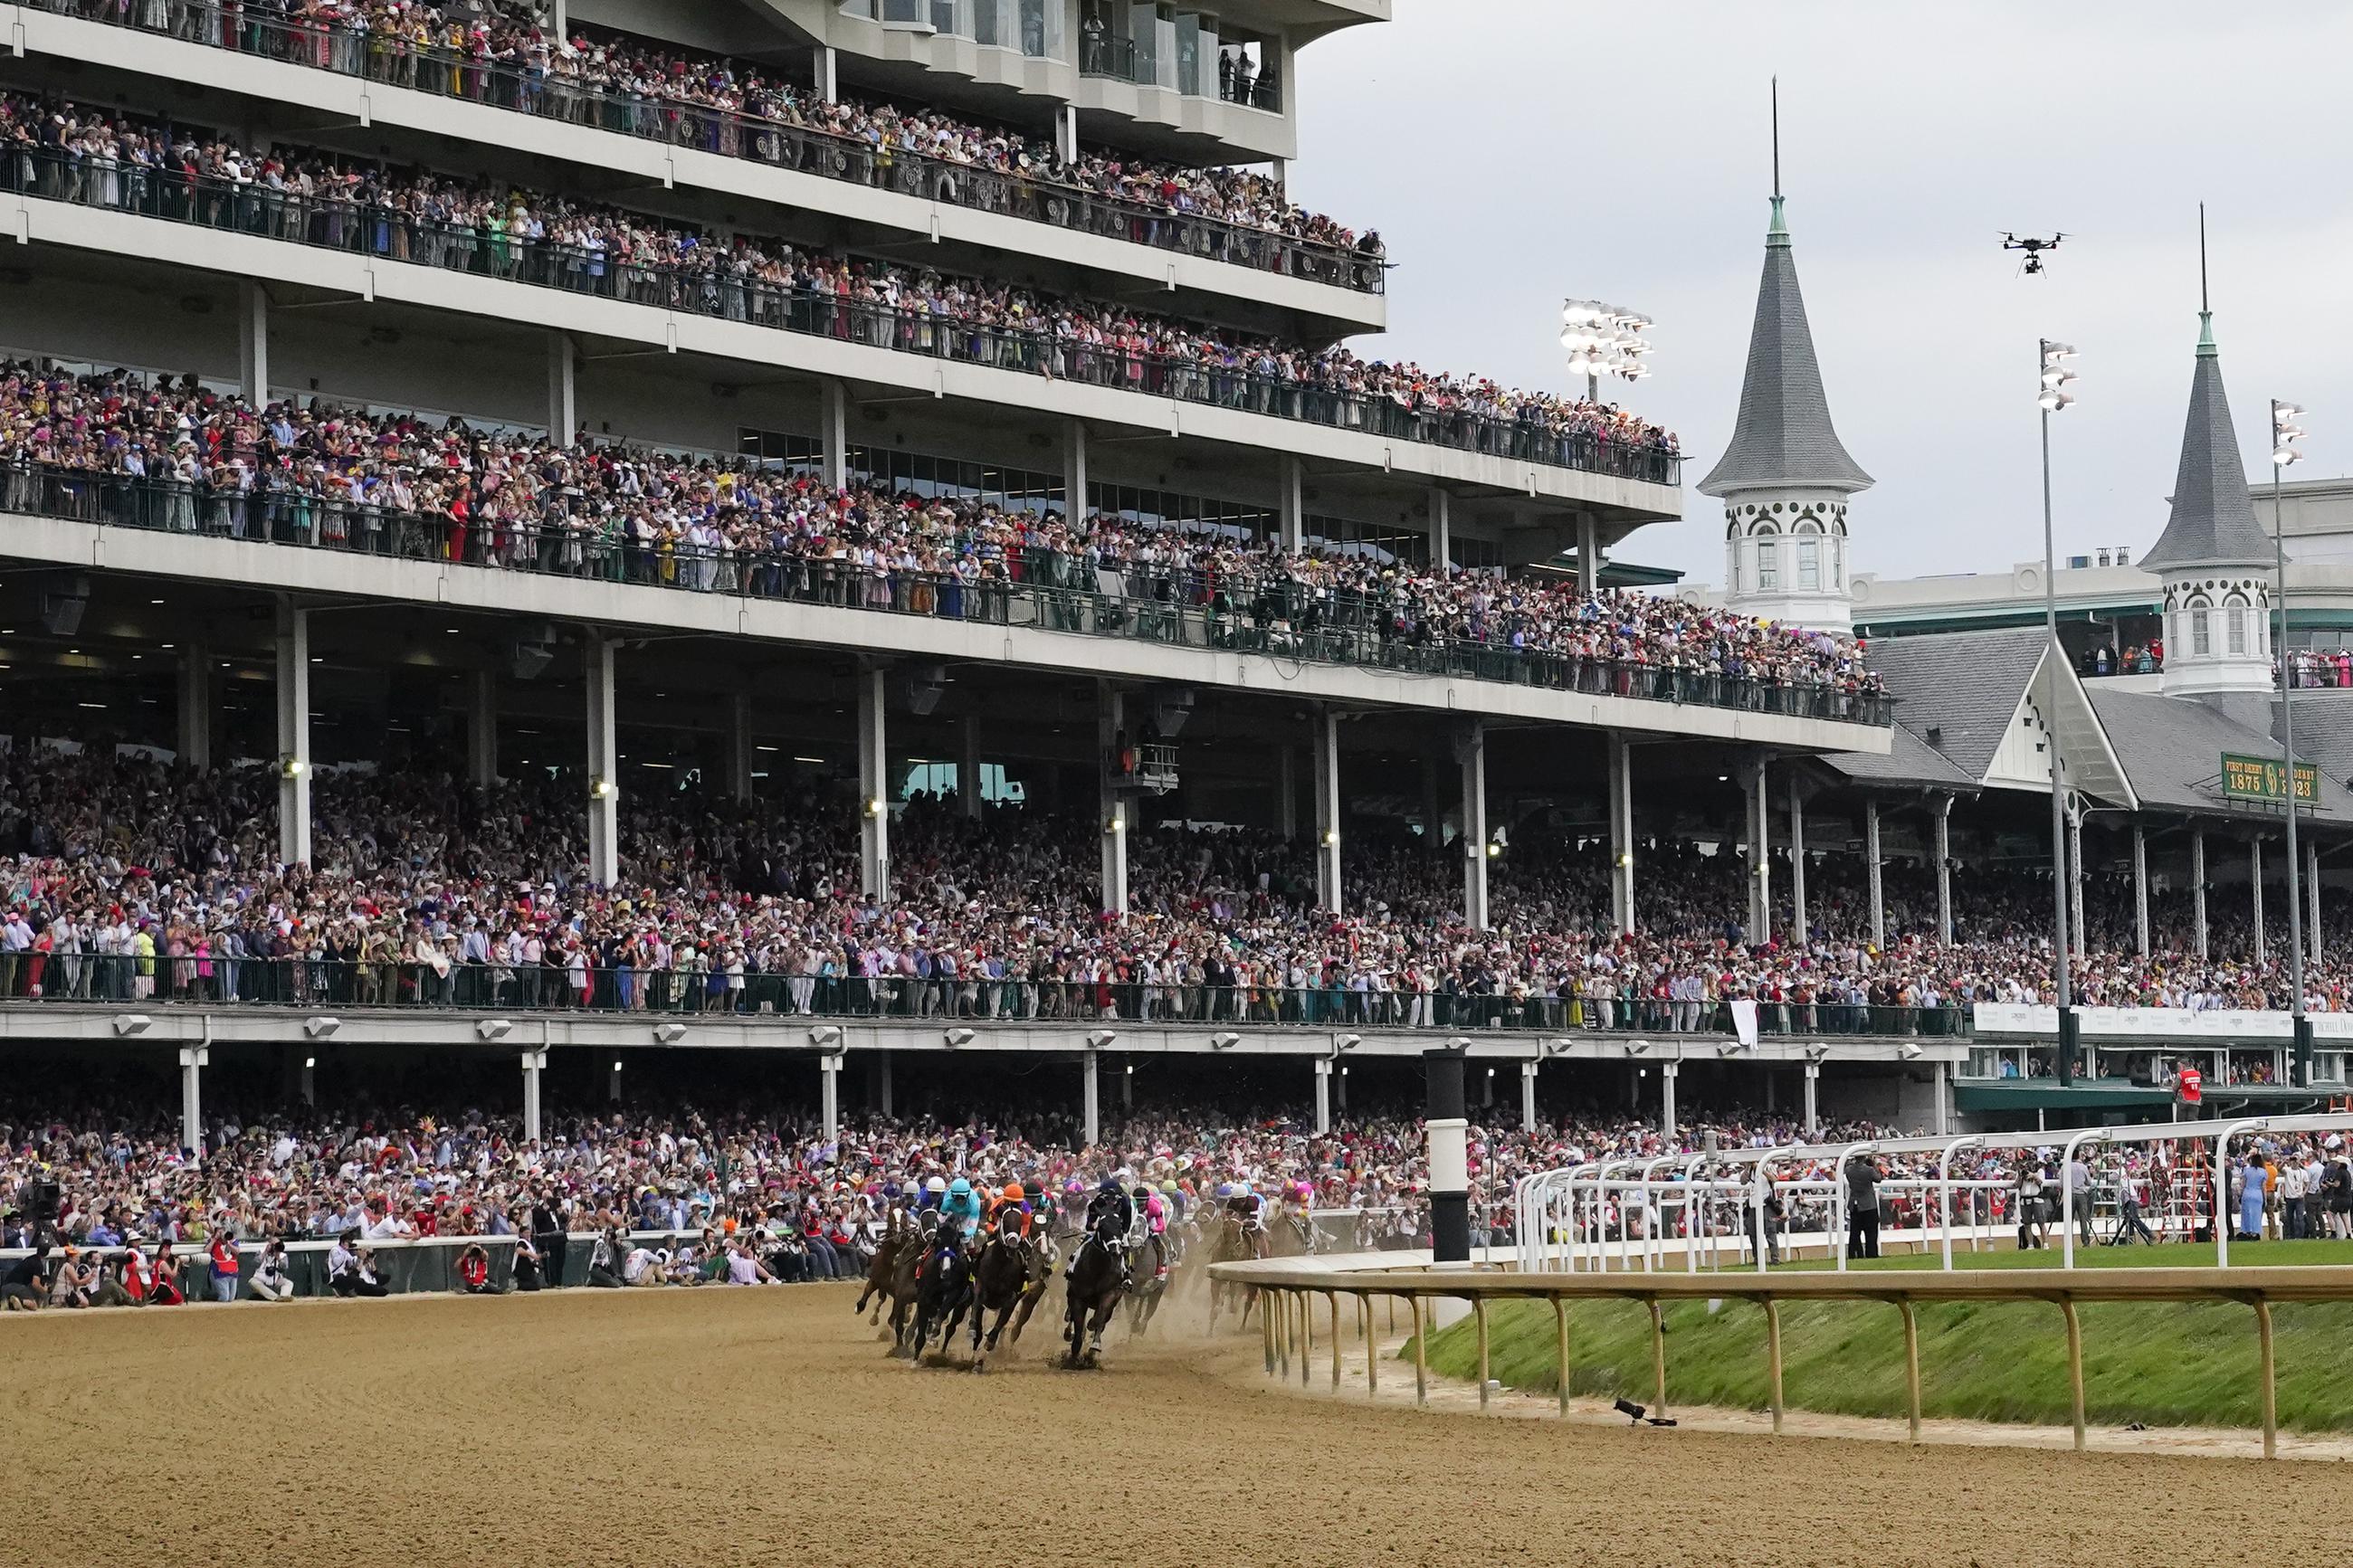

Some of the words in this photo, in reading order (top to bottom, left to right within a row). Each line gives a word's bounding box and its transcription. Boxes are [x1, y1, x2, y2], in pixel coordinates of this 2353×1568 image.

[2225, 761, 2243, 773] FIRST
[2243, 763, 2262, 775] DERBY
[2293, 768, 2315, 781] DERBY
[2230, 774, 2260, 792] 1875
